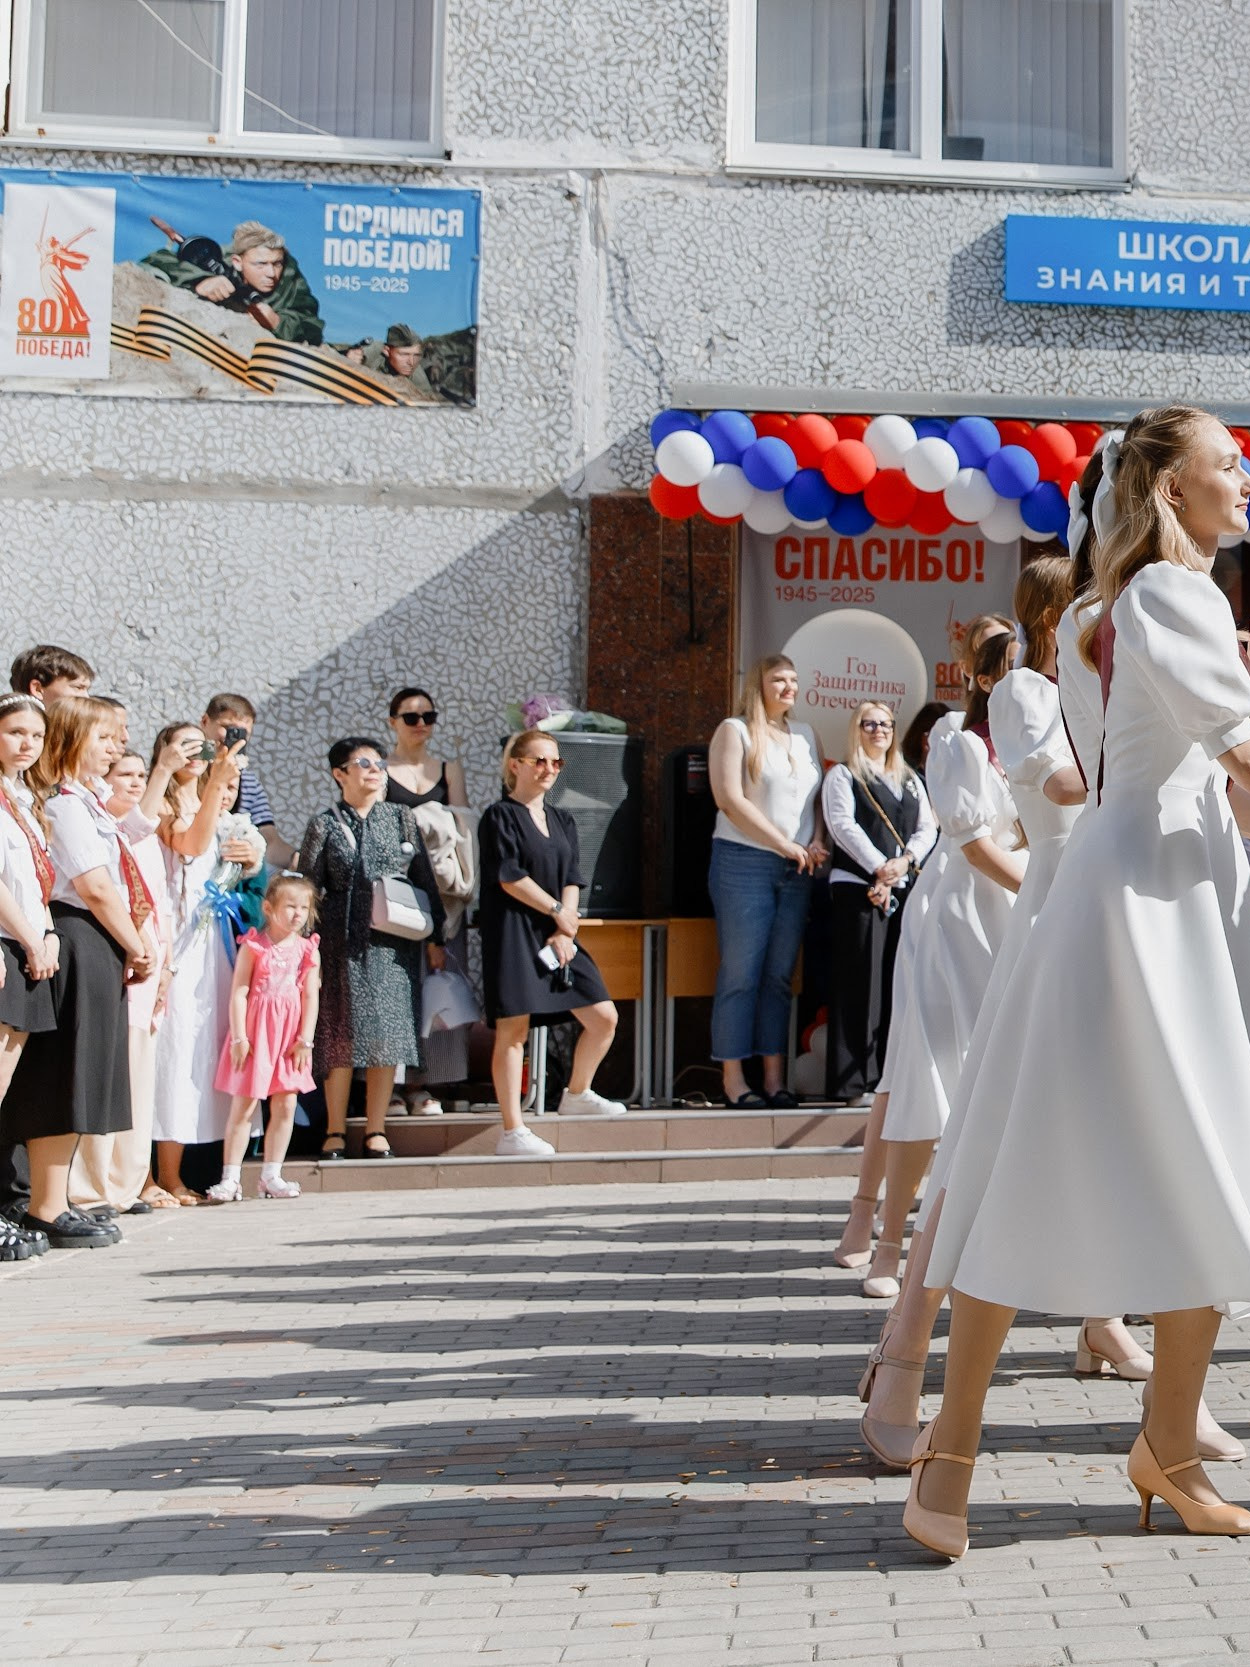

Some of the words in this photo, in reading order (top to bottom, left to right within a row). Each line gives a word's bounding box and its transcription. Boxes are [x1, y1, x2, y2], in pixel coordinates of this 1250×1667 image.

[324, 203, 465, 238] ГОРДИМСЯ
[324, 237, 451, 271] ПОБЕДОЙ!
[1036, 266, 1186, 296] ЗНАНИЯ
[1199, 273, 1221, 297] И
[17, 298, 54, 333] 80
[16, 339, 91, 359] ПОБЕДА!
[774, 536, 985, 583] СПАСИБО!
[813, 670, 906, 695] Защитника
[846, 656, 877, 678] Год
[806, 688, 902, 714] Отечеа!
